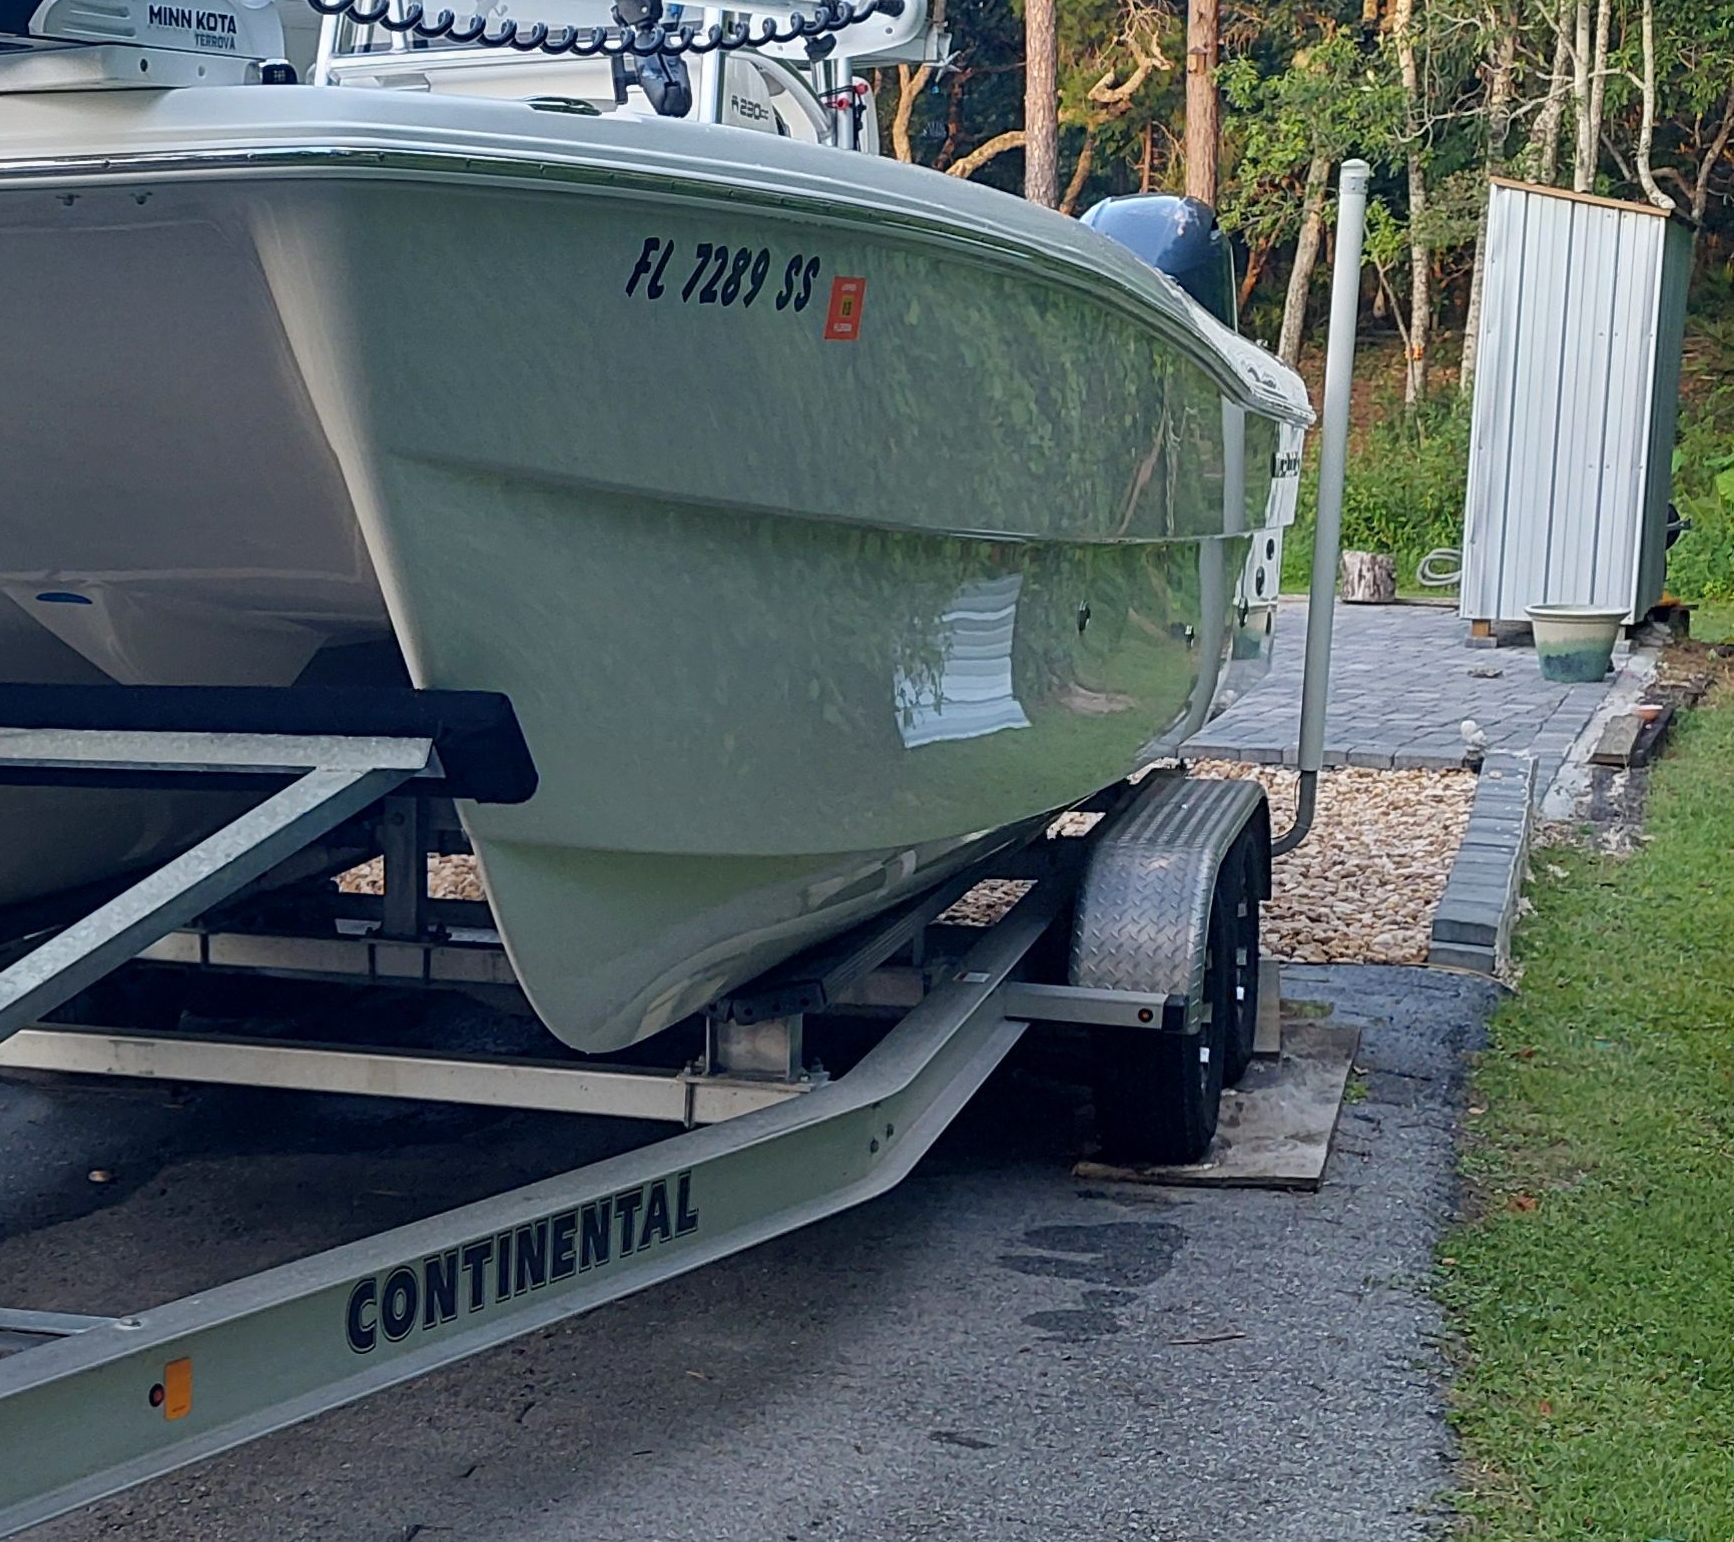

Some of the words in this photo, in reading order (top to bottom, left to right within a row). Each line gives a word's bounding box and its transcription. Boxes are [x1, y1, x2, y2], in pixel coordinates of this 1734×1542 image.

[149, 5, 192, 29] MINN
[196, 10, 237, 34] KOTA
[195, 34, 235, 50] TERROVA
[625, 237, 675, 300] FL
[681, 242, 770, 309] 7289
[775, 254, 821, 312] SS
[346, 1170, 699, 1354] CONTINENTAL
